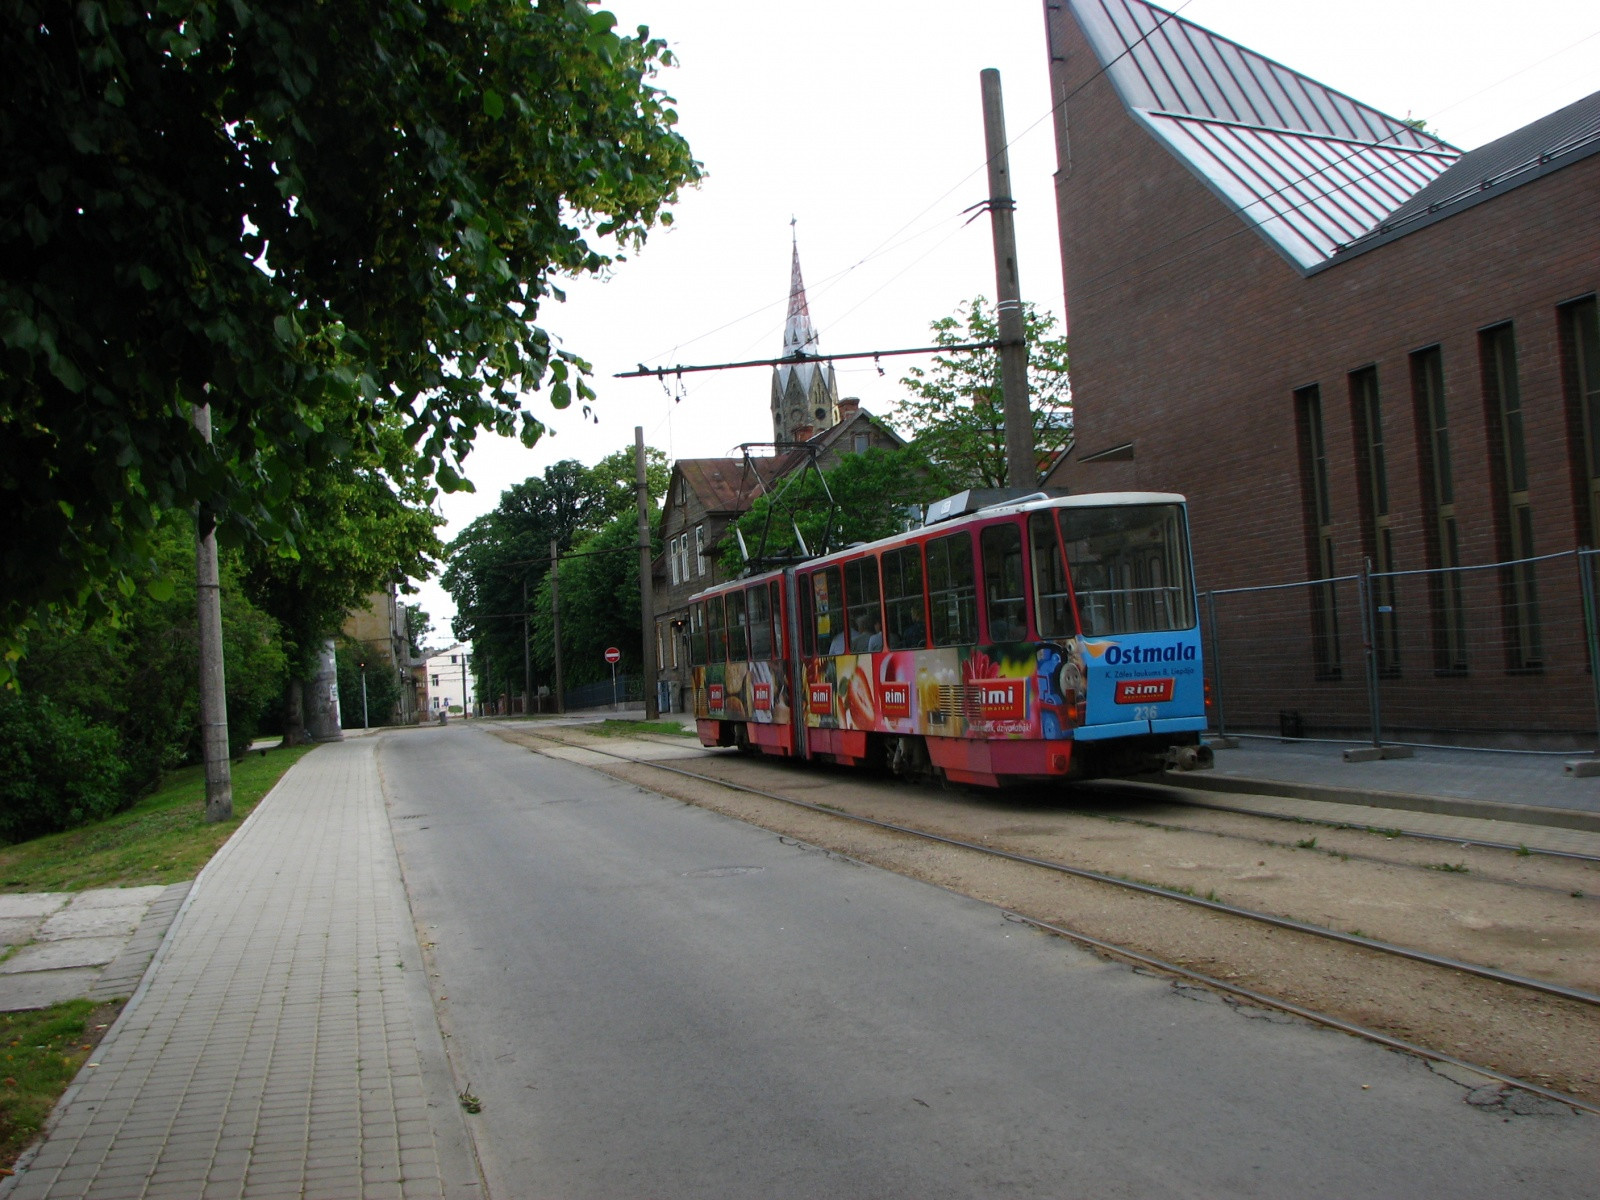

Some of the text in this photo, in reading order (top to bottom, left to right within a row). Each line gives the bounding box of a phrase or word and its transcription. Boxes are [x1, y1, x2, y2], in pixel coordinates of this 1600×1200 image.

[1104, 642, 1196, 665] Ostmala
[1134, 668, 1161, 678] laukums
[1134, 705, 1158, 720] 236
